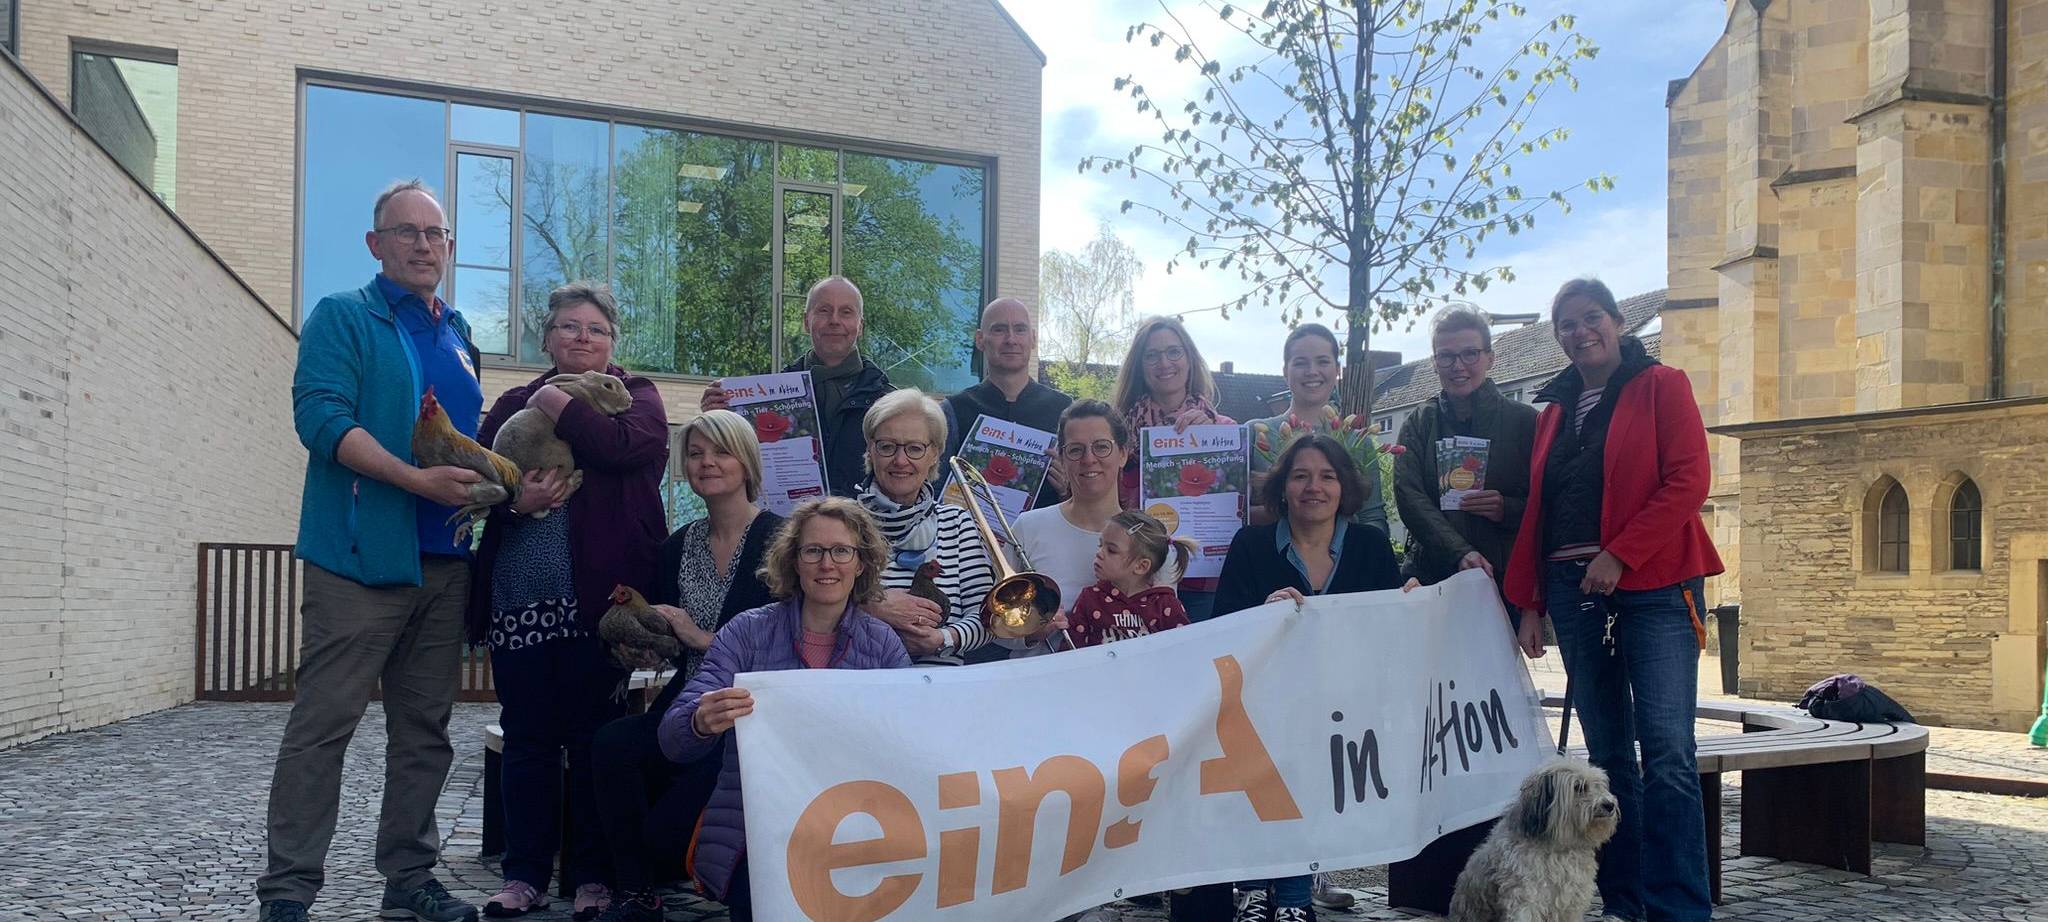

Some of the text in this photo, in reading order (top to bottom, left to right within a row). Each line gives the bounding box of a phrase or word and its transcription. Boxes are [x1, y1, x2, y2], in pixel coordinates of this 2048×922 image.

[754, 406, 768, 414] Tier
[774, 400, 811, 411] Schöpfung
[1012, 454, 1045, 467] Schöpfung
[1146, 460, 1175, 469] Mensch
[1181, 458, 1196, 466] Tier
[1203, 455, 1244, 465] Schöpfung
[1330, 710, 1389, 814] in
[1420, 677, 1519, 794] Aktion
